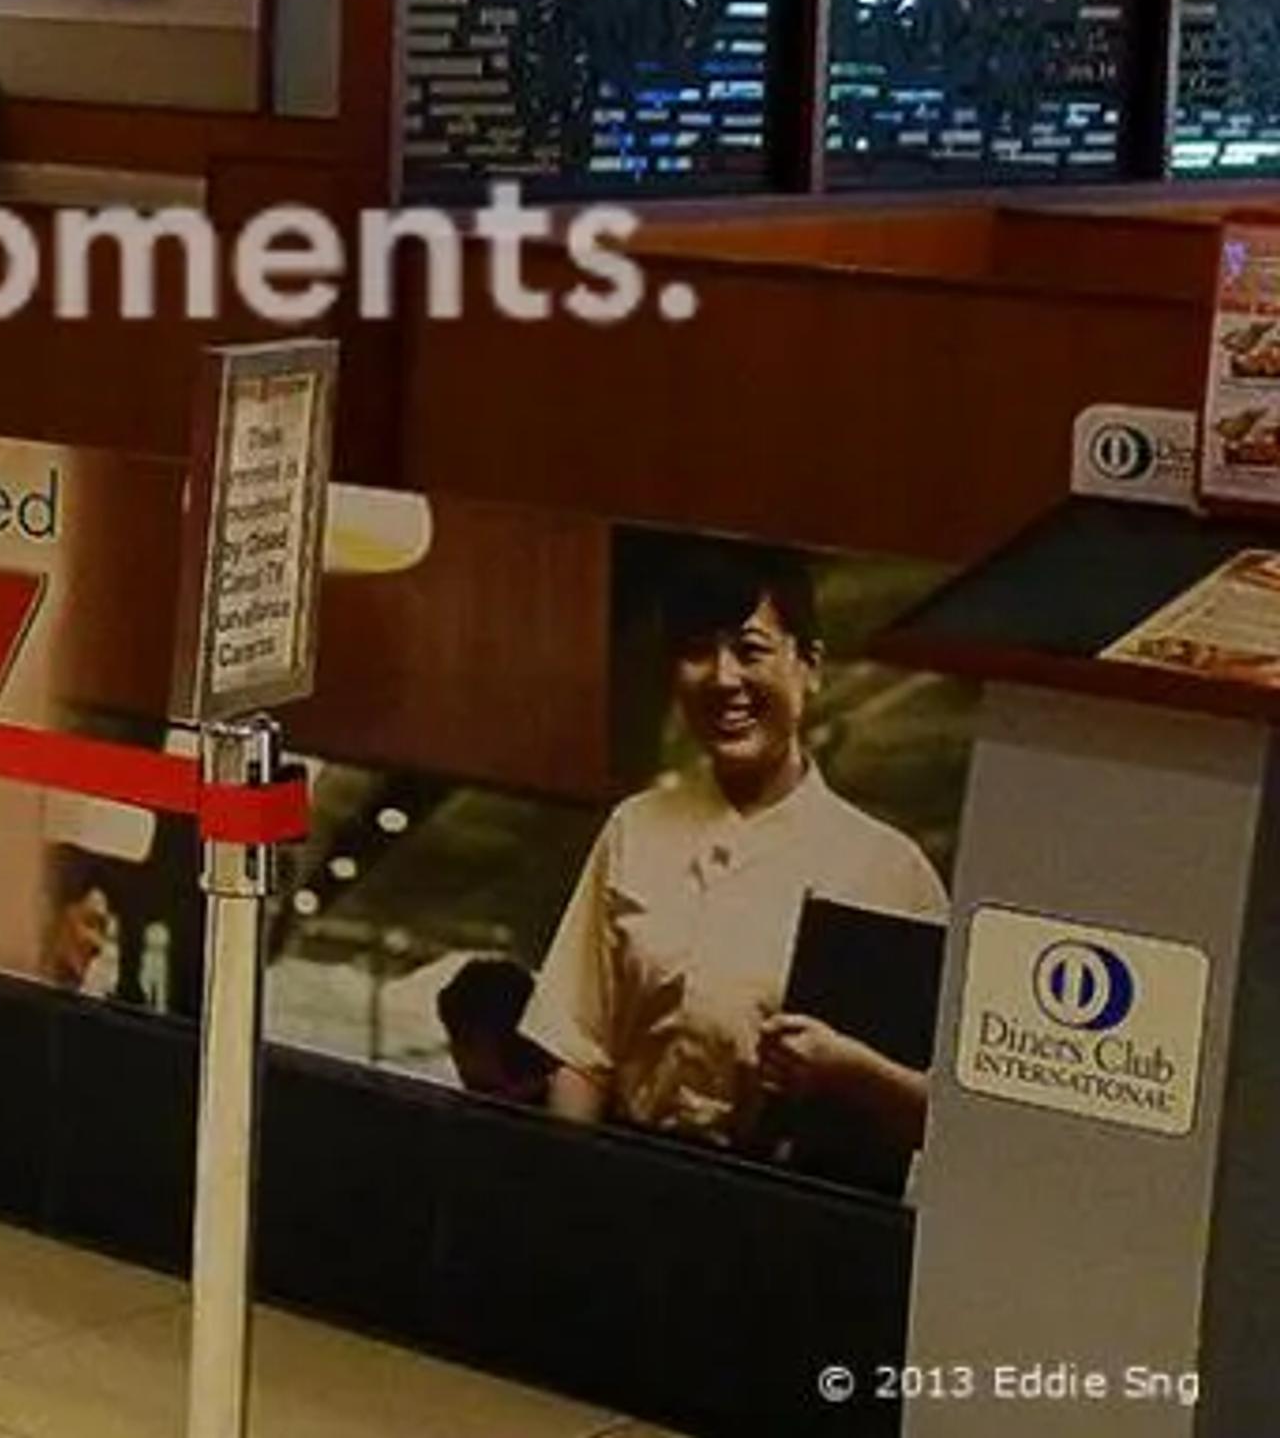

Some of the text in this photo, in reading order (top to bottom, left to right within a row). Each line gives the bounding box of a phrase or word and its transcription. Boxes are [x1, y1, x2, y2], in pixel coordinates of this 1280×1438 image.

[980, 1011, 1175, 1084] Diners Club
[973, 1052, 1170, 1111] INTERNATIONAL
